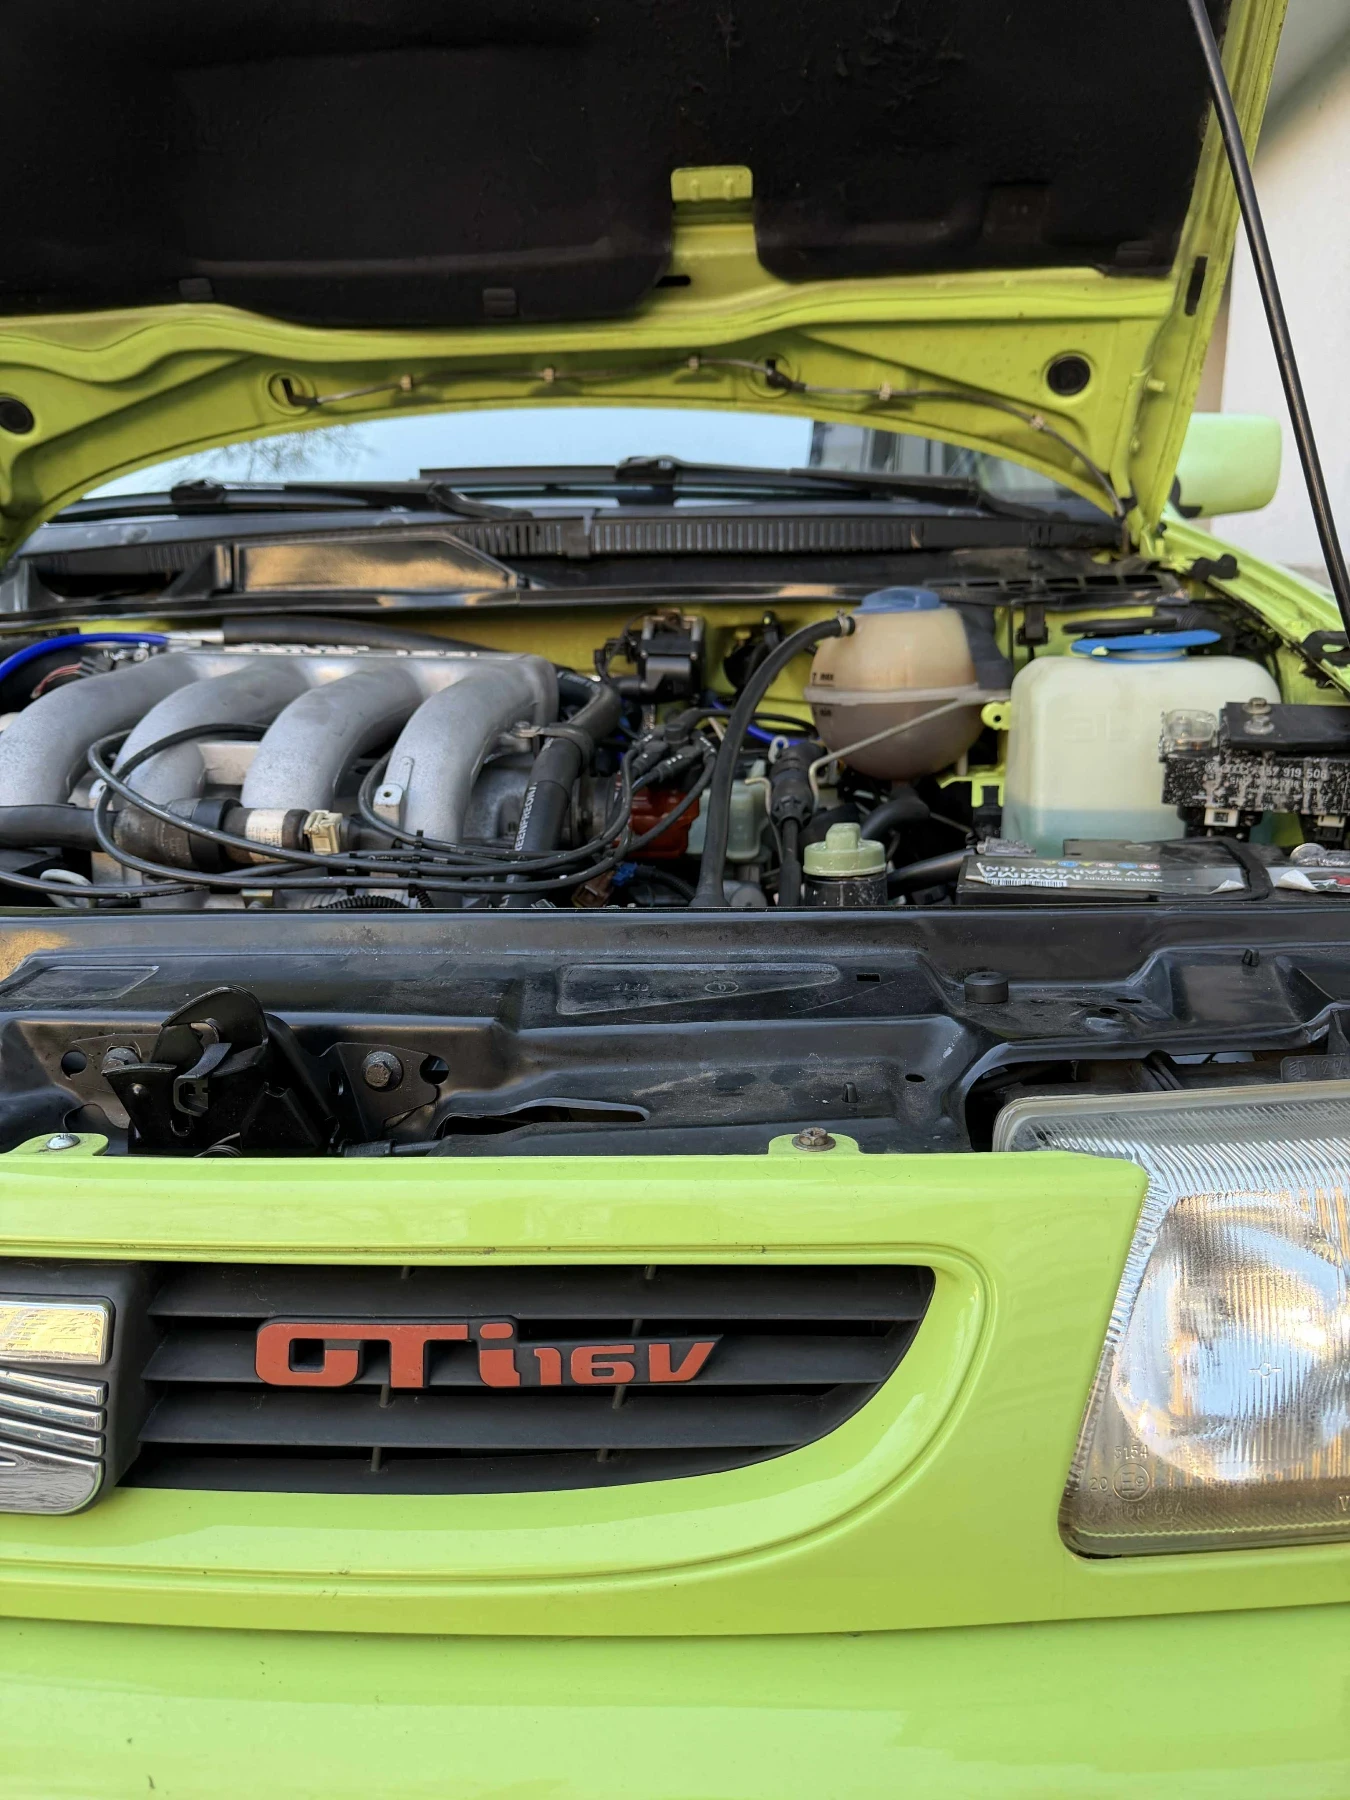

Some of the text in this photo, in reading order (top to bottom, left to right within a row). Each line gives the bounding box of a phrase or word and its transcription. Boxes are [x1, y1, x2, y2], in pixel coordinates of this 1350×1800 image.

[1283, 767, 1302, 778] 919
[984, 872, 1082, 881] MAXIMA
[533, 1341, 717, 1386] 16V
[1089, 1476, 1109, 1492] 20
